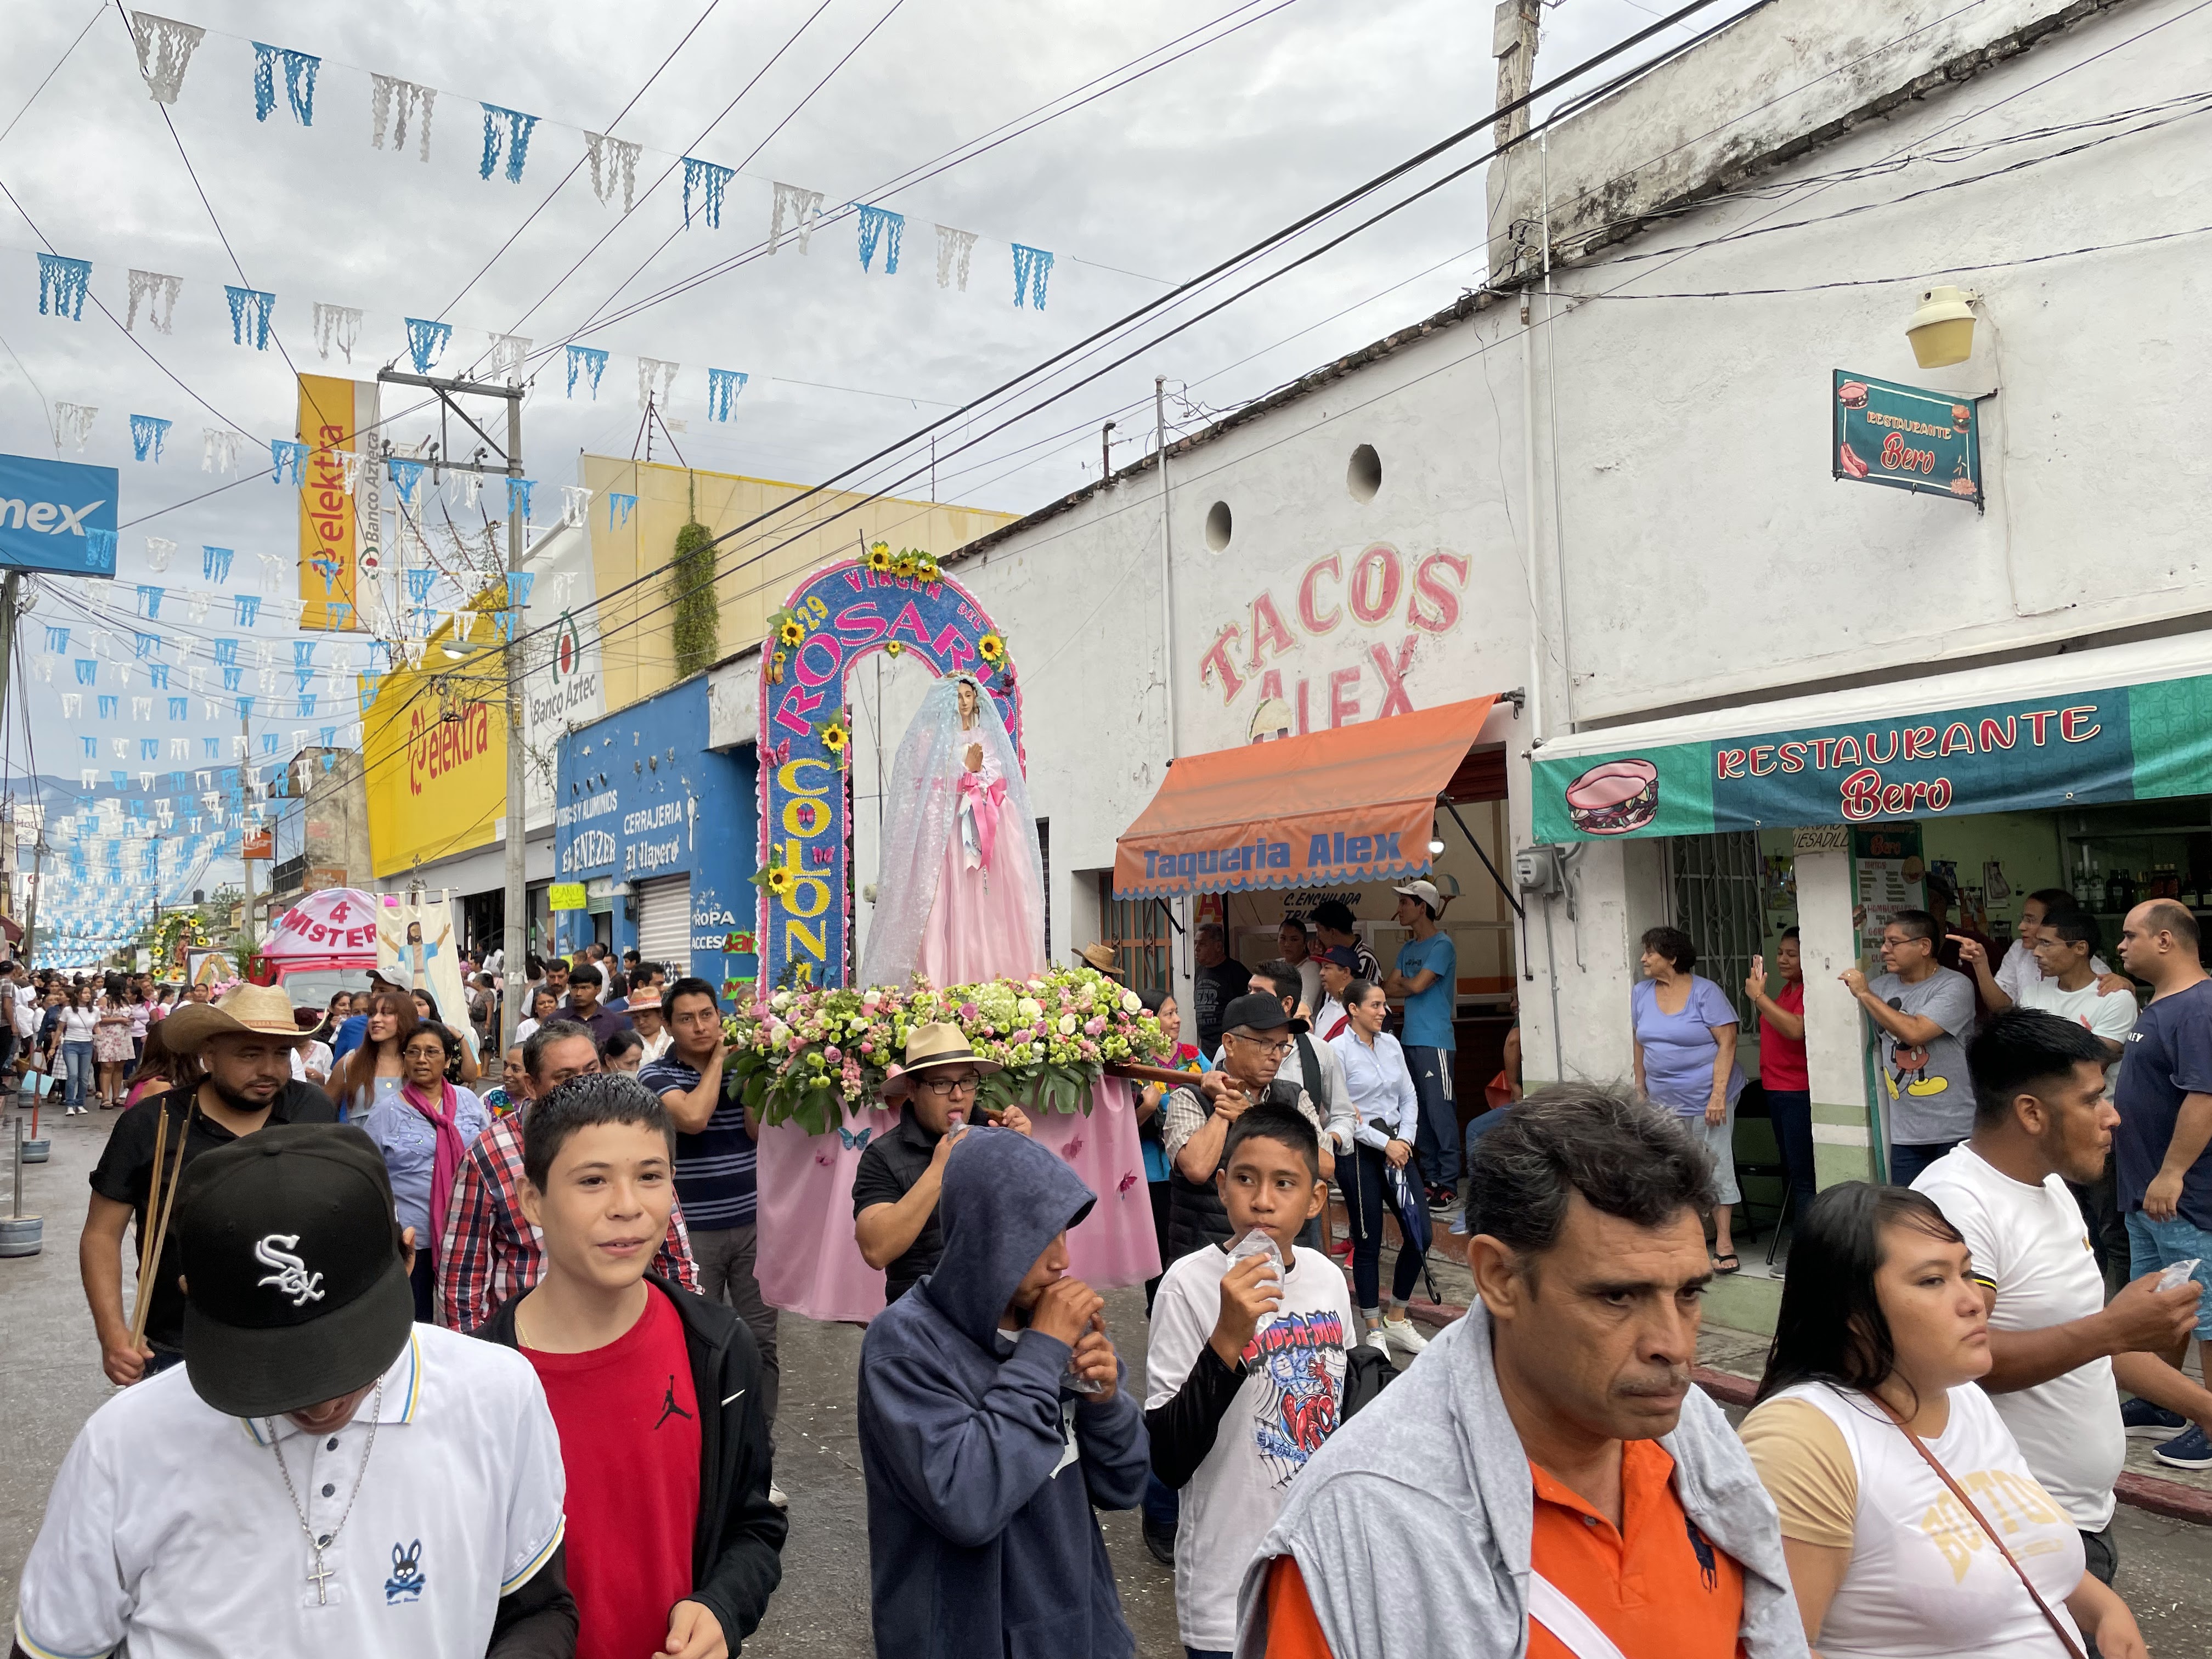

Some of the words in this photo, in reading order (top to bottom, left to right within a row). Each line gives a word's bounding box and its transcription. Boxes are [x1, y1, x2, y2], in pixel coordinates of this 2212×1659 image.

[1866, 410, 1953, 441] RESTAURANTE
[365, 432, 380, 489] Azteca
[1880, 431, 1936, 475] Bero
[311, 425, 344, 541] elektra
[365, 492, 380, 543] Banco
[797, 595, 829, 632] 29
[843, 569, 944, 602] VIRGEN
[1200, 542, 1471, 706] TACOS
[533, 691, 563, 727] Banco
[429, 696, 488, 780] elektra
[1717, 704, 2101, 780] RESTAURANTE
[583, 789, 618, 821] ALUMINIOS
[624, 800, 682, 836] CERRAJERIA
[1840, 768, 1952, 822] Bero
[1144, 837, 1290, 882] Taqueria
[1307, 831, 1403, 870] Alex
[280, 907, 377, 948] MISTER
[694, 911, 736, 926] ROPA
[1922, 1469, 2075, 1584] BOTON
